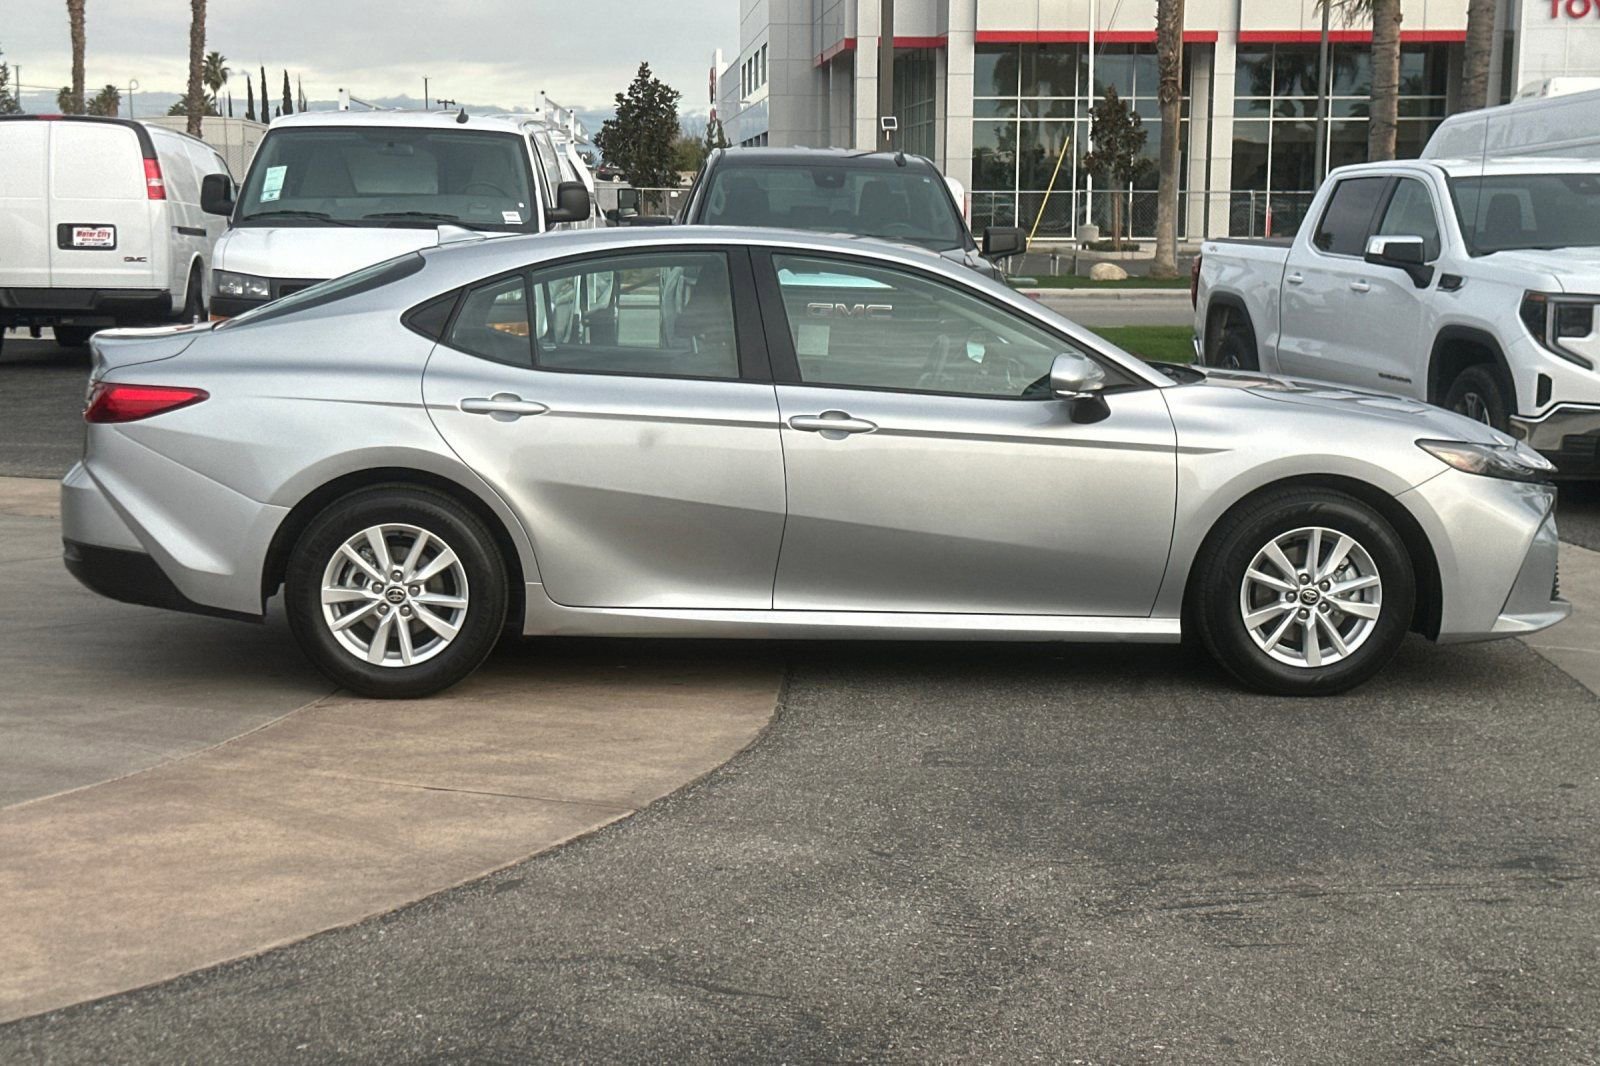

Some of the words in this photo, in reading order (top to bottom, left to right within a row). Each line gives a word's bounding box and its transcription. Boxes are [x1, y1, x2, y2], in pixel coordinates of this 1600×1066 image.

[1551, 0, 1600, 19] TO
[97, 229, 111, 240] City
[807, 302, 893, 319] GMC
